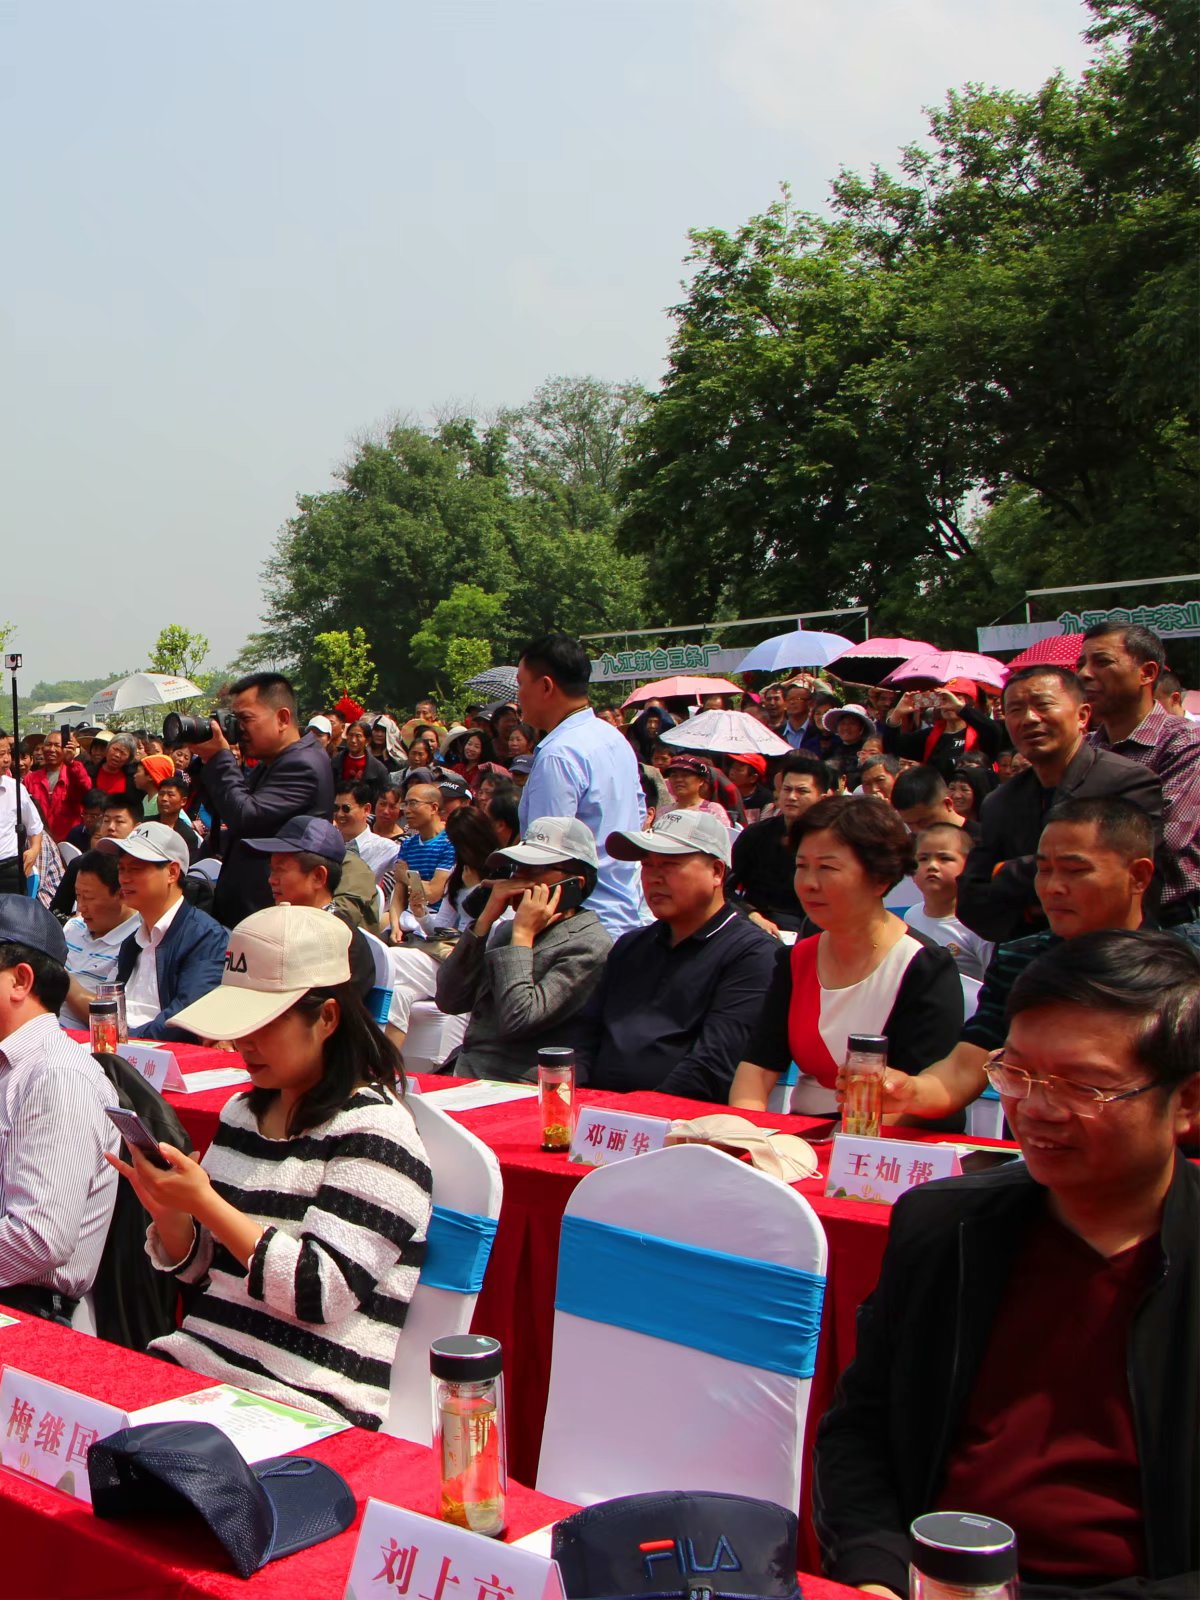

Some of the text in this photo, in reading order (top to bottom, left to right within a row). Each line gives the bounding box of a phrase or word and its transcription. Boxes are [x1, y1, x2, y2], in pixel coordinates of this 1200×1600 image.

[602, 643, 720, 675] 九江新合豆条厂
[584, 1123, 650, 1155] 邓丽华
[843, 1152, 934, 1185] 王灿帮
[6, 1396, 99, 1470] 梅继国
[639, 1534, 742, 1579] FILA
